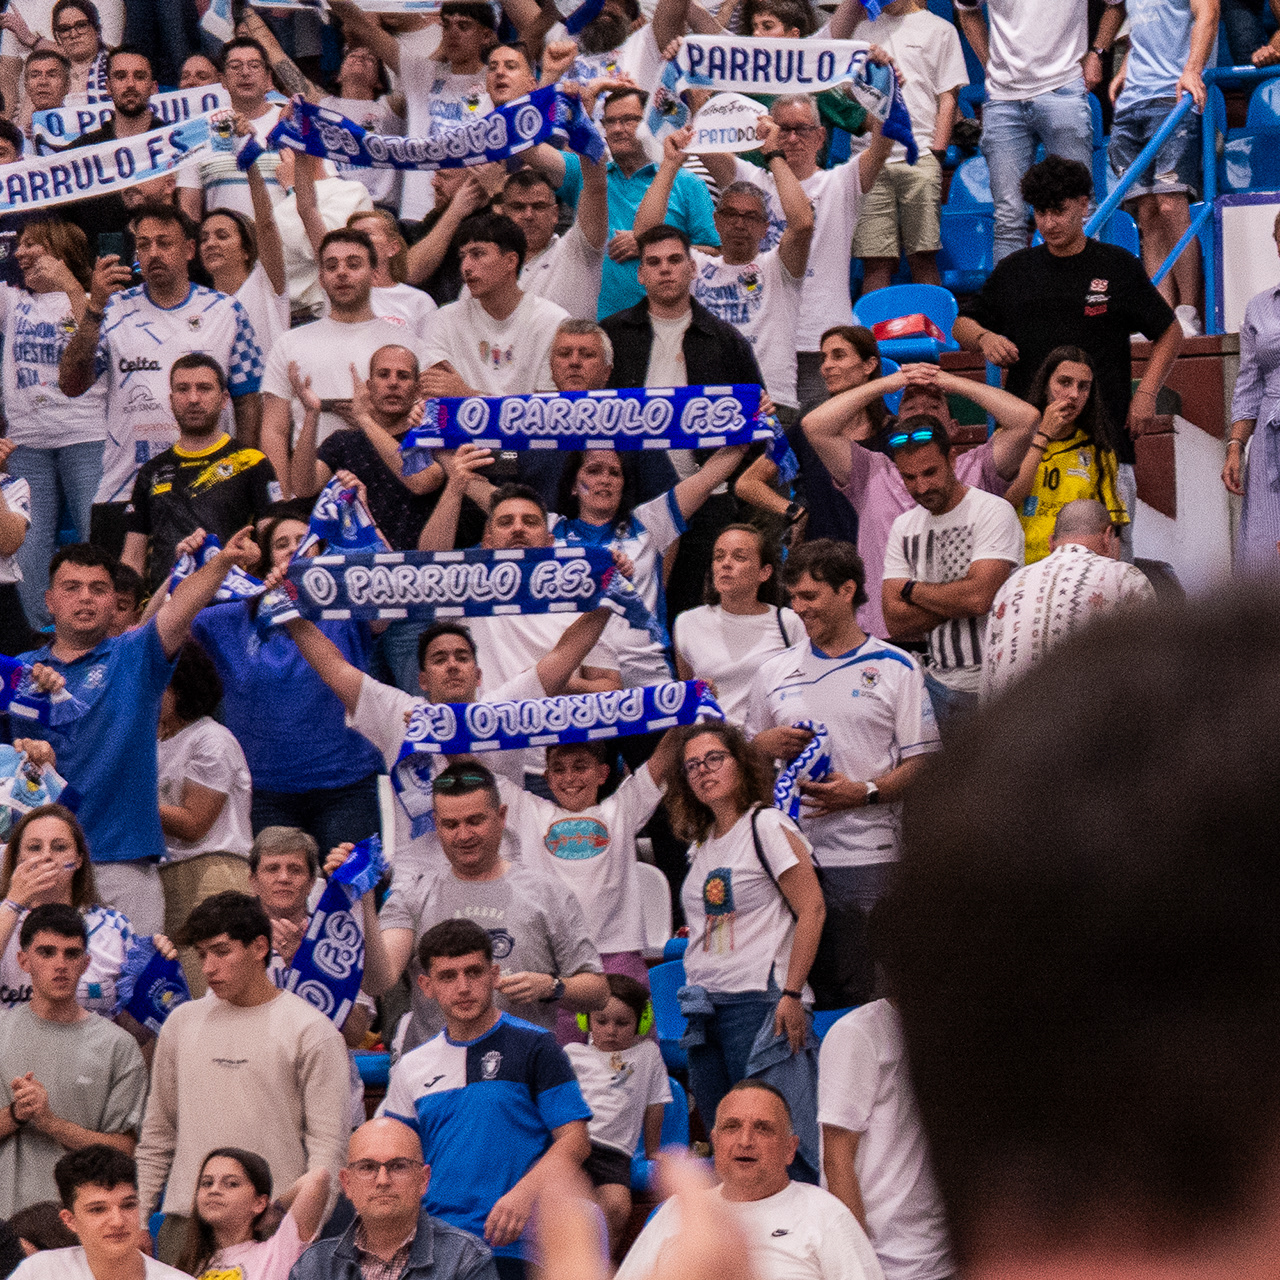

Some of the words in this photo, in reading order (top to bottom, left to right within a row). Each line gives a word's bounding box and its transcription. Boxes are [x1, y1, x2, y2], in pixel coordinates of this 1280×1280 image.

[686, 43, 836, 84] PARRULO
[45, 110, 66, 137] O
[0, 146, 137, 205] ARRULO
[118, 357, 163, 374] Celta
[457, 397, 490, 435] O
[500, 397, 674, 436] PARRULO
[1042, 466, 1061, 491] 10
[304, 558, 337, 605] O
[345, 556, 522, 603] PARRULO
[465, 687, 645, 739] PARRULO
[654, 681, 687, 715] O
